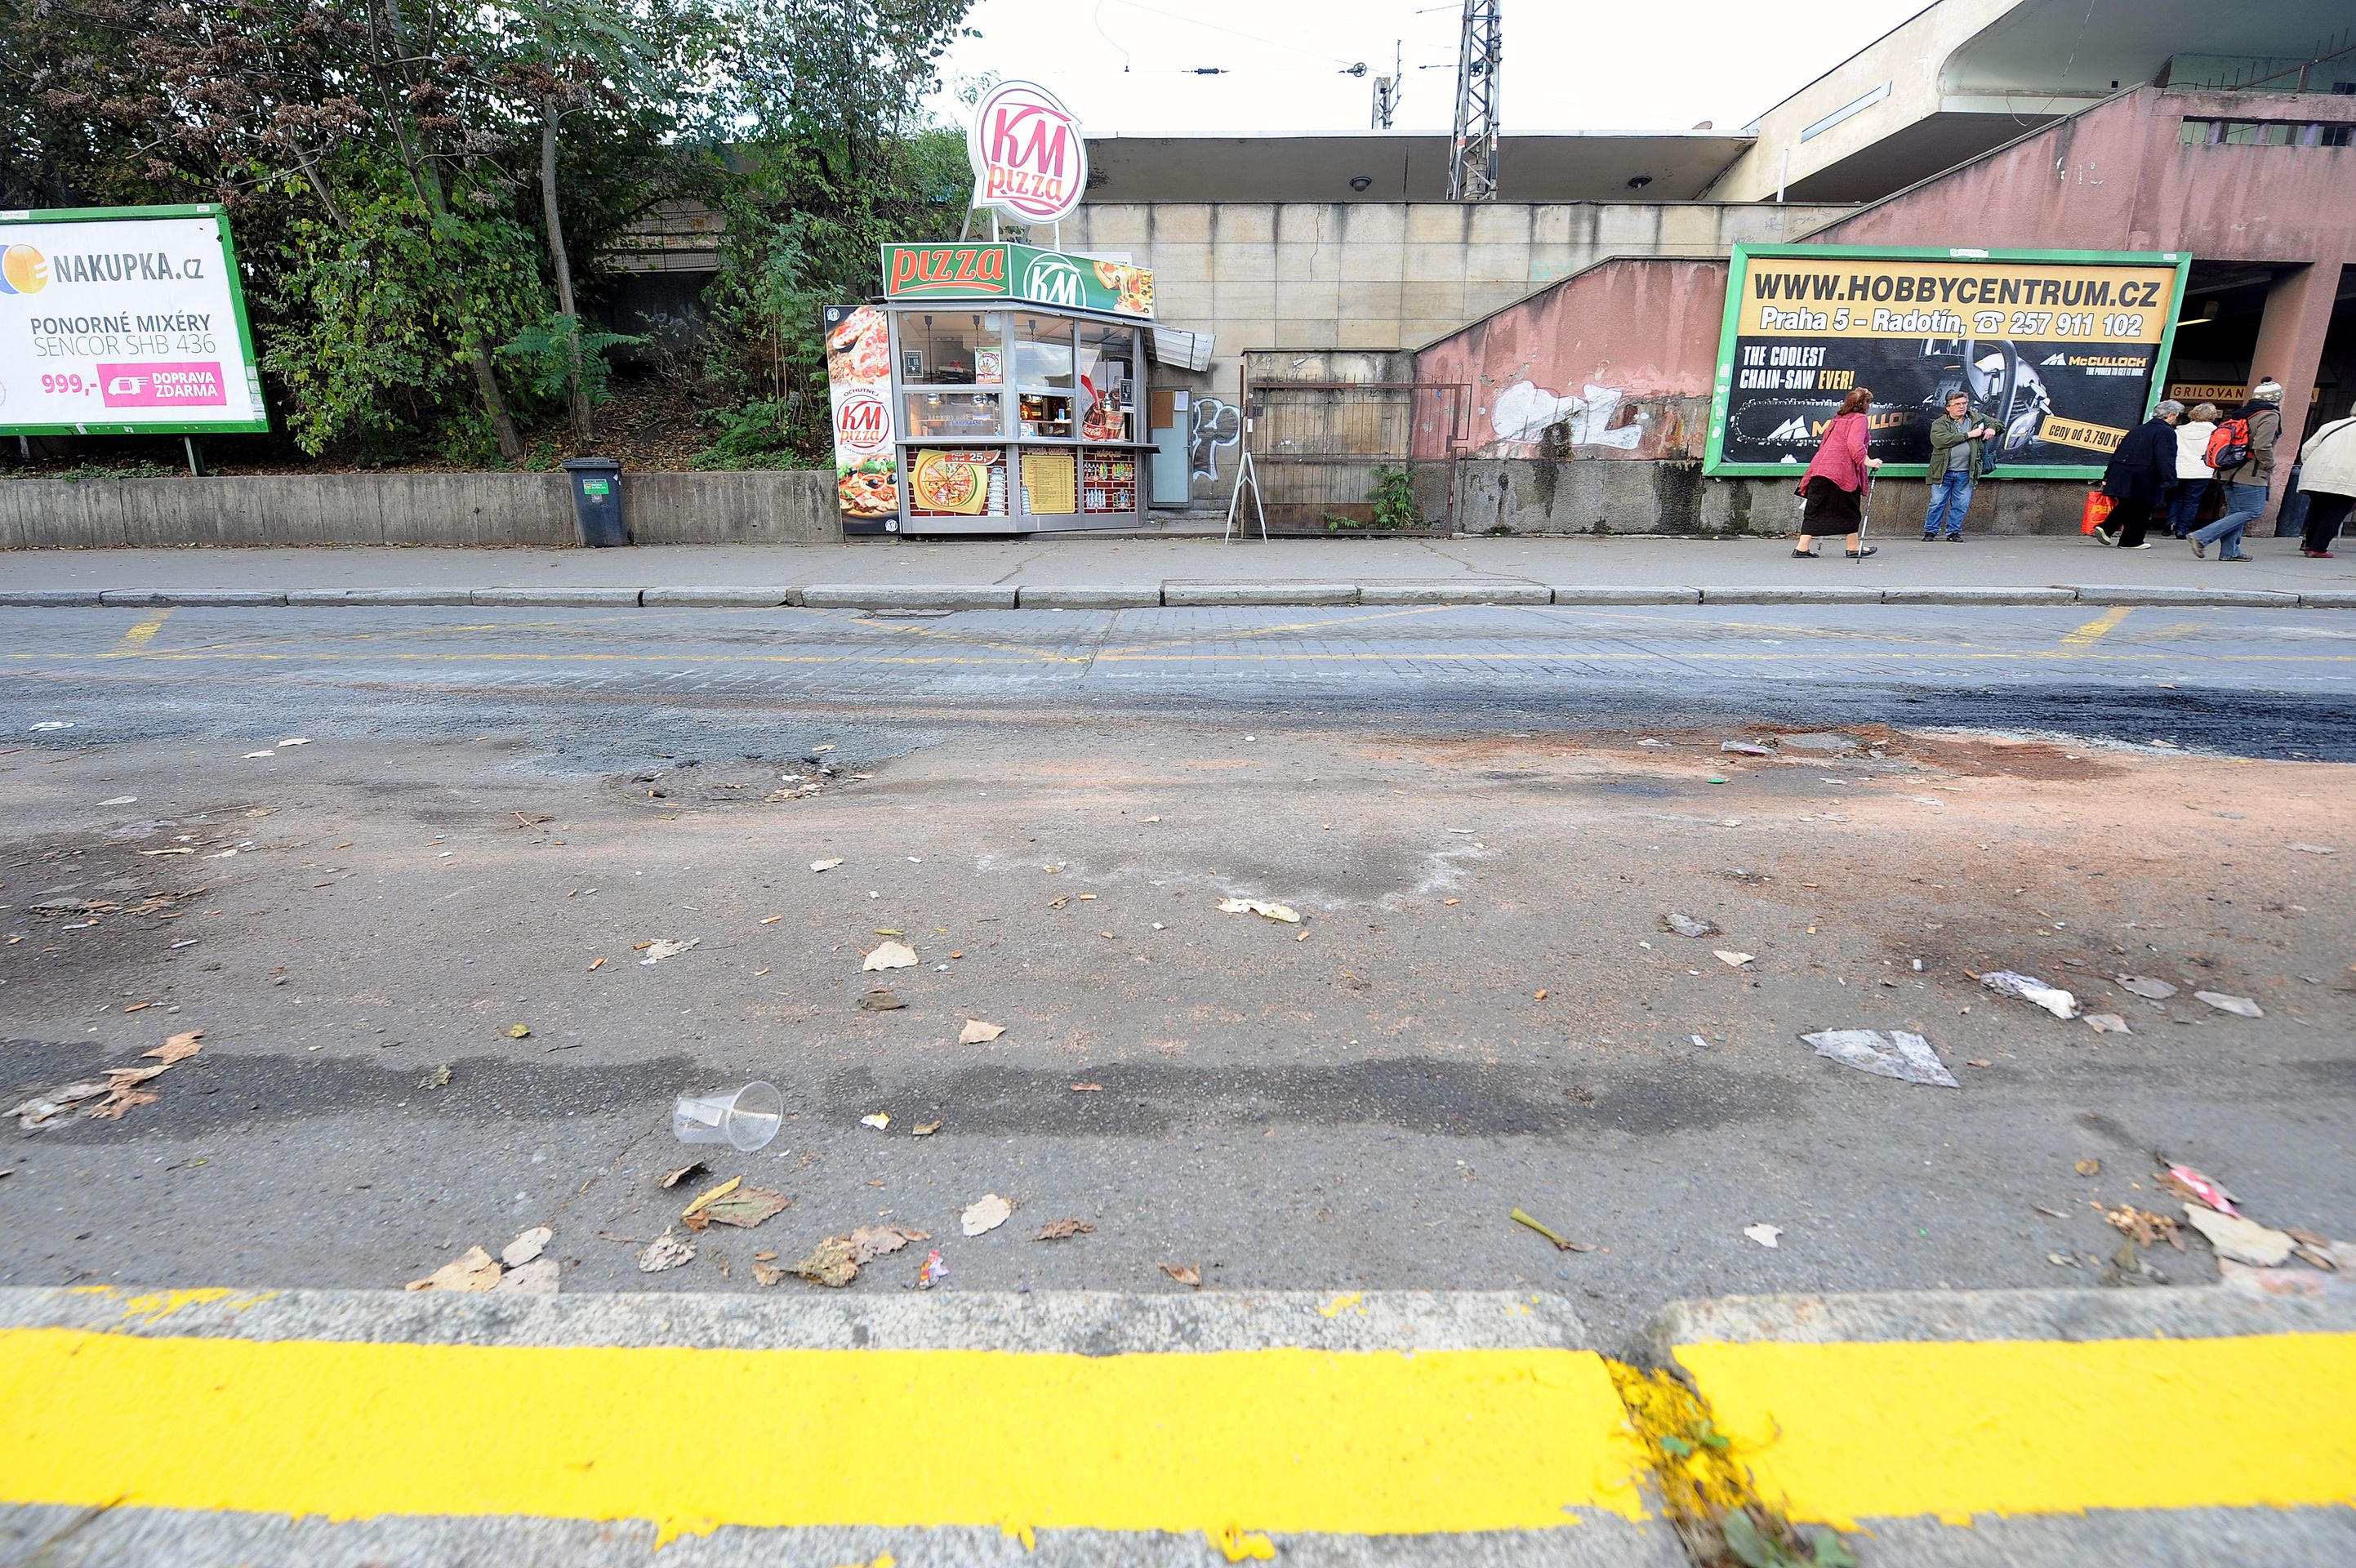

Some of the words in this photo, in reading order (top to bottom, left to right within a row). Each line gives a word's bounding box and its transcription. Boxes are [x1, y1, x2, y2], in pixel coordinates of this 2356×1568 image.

[991, 103, 1071, 177] KM
[986, 163, 1062, 204] pizza
[889, 248, 1006, 295] pizza
[1031, 261, 1082, 306] KM
[1755, 274, 2161, 307] WWW.HOBBYCENTRUM.CZ
[30, 311, 131, 334] PONORNÉ
[136, 310, 211, 332] MIXÉRY
[1760, 306, 1828, 331] Praha
[1833, 308, 1850, 331] 5
[1872, 308, 1966, 337] Radotín,
[2008, 311, 2053, 335] 257
[2055, 312, 2095, 336] 911
[2104, 314, 2144, 336] 102
[34, 336, 121, 357] SENCOR
[126, 334, 169, 355] SHB
[176, 333, 216, 354] 436
[1743, 345, 1767, 366] THE
[1770, 346, 1827, 367] COOLEST
[152, 372, 216, 385] DOPRAVA
[1739, 369, 1815, 390] CHAIN-SAW
[1818, 370, 1855, 390] EVER!
[155, 384, 218, 398] ZDARMA
[842, 401, 883, 430] KM
[840, 430, 880, 445] pizza
[2048, 425, 2071, 441] ceny
[2071, 428, 2083, 441] od
[2084, 430, 2111, 447] 3.790
